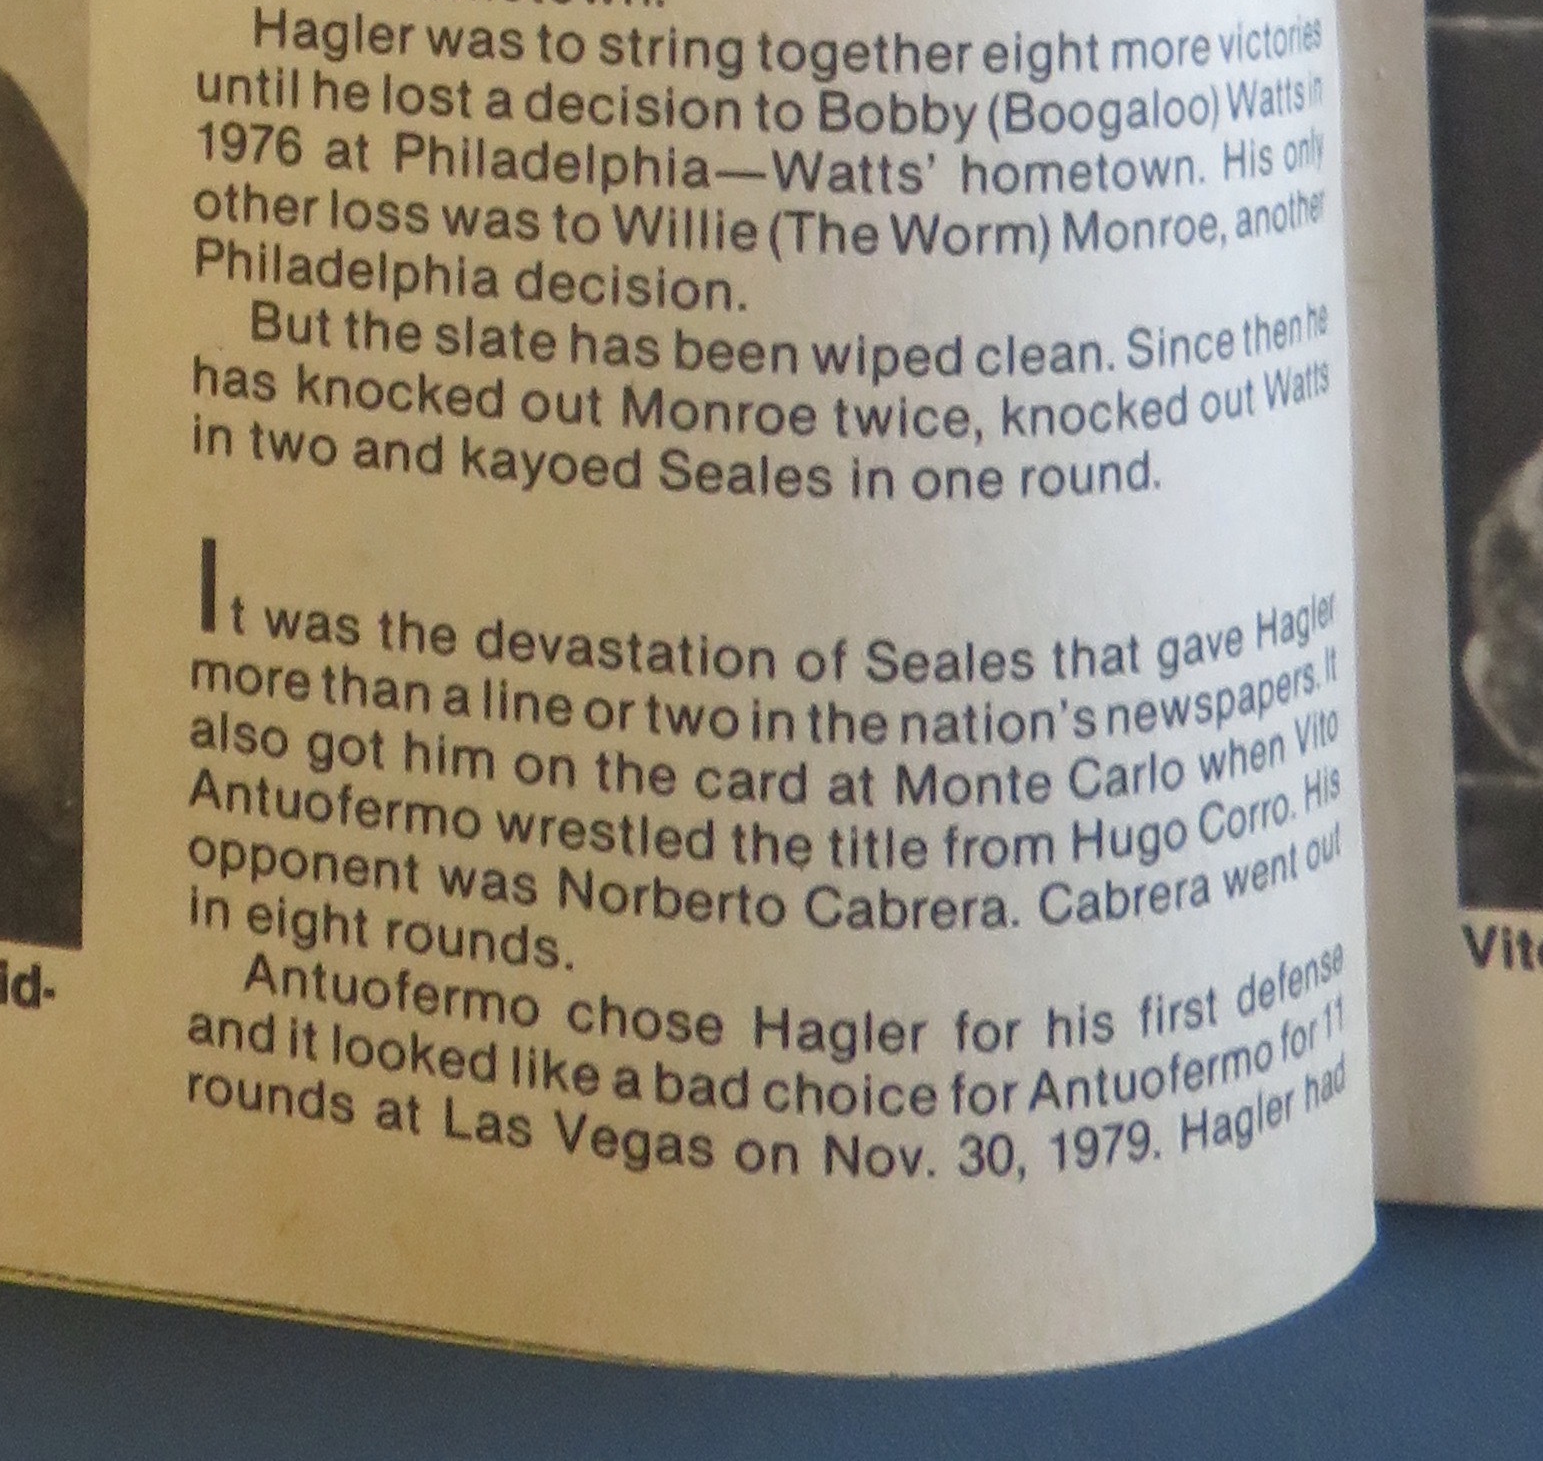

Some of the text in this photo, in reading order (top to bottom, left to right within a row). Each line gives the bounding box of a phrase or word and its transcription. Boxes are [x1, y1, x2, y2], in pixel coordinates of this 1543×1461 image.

[197, 120, 303, 167] 1976
[324, 133, 370, 173] at
[961, 153, 1206, 195] hometown.
[1223, 140, 1274, 180] His
[1283, 128, 1323, 173] only
[195, 235, 747, 312] Philadelphia decision.
[193, 412, 1161, 501] in two and kayoed Seales in one round.
[200, 536, 1335, 684] It was the devastation of Seales that gave Hagler
[188, 767, 1341, 870] Antuofermo wrestled the title from Hugo Corro. His
[190, 884, 574, 971] in eight rounds.
[1461, 924, 1543, 972] Vit
[244, 942, 1344, 1064] Antuofermo chose Hagler for his first defense
[188, 1052, 1346, 1182] rounds at Las Vegas on Nov. 30, 1979. Hagler had
